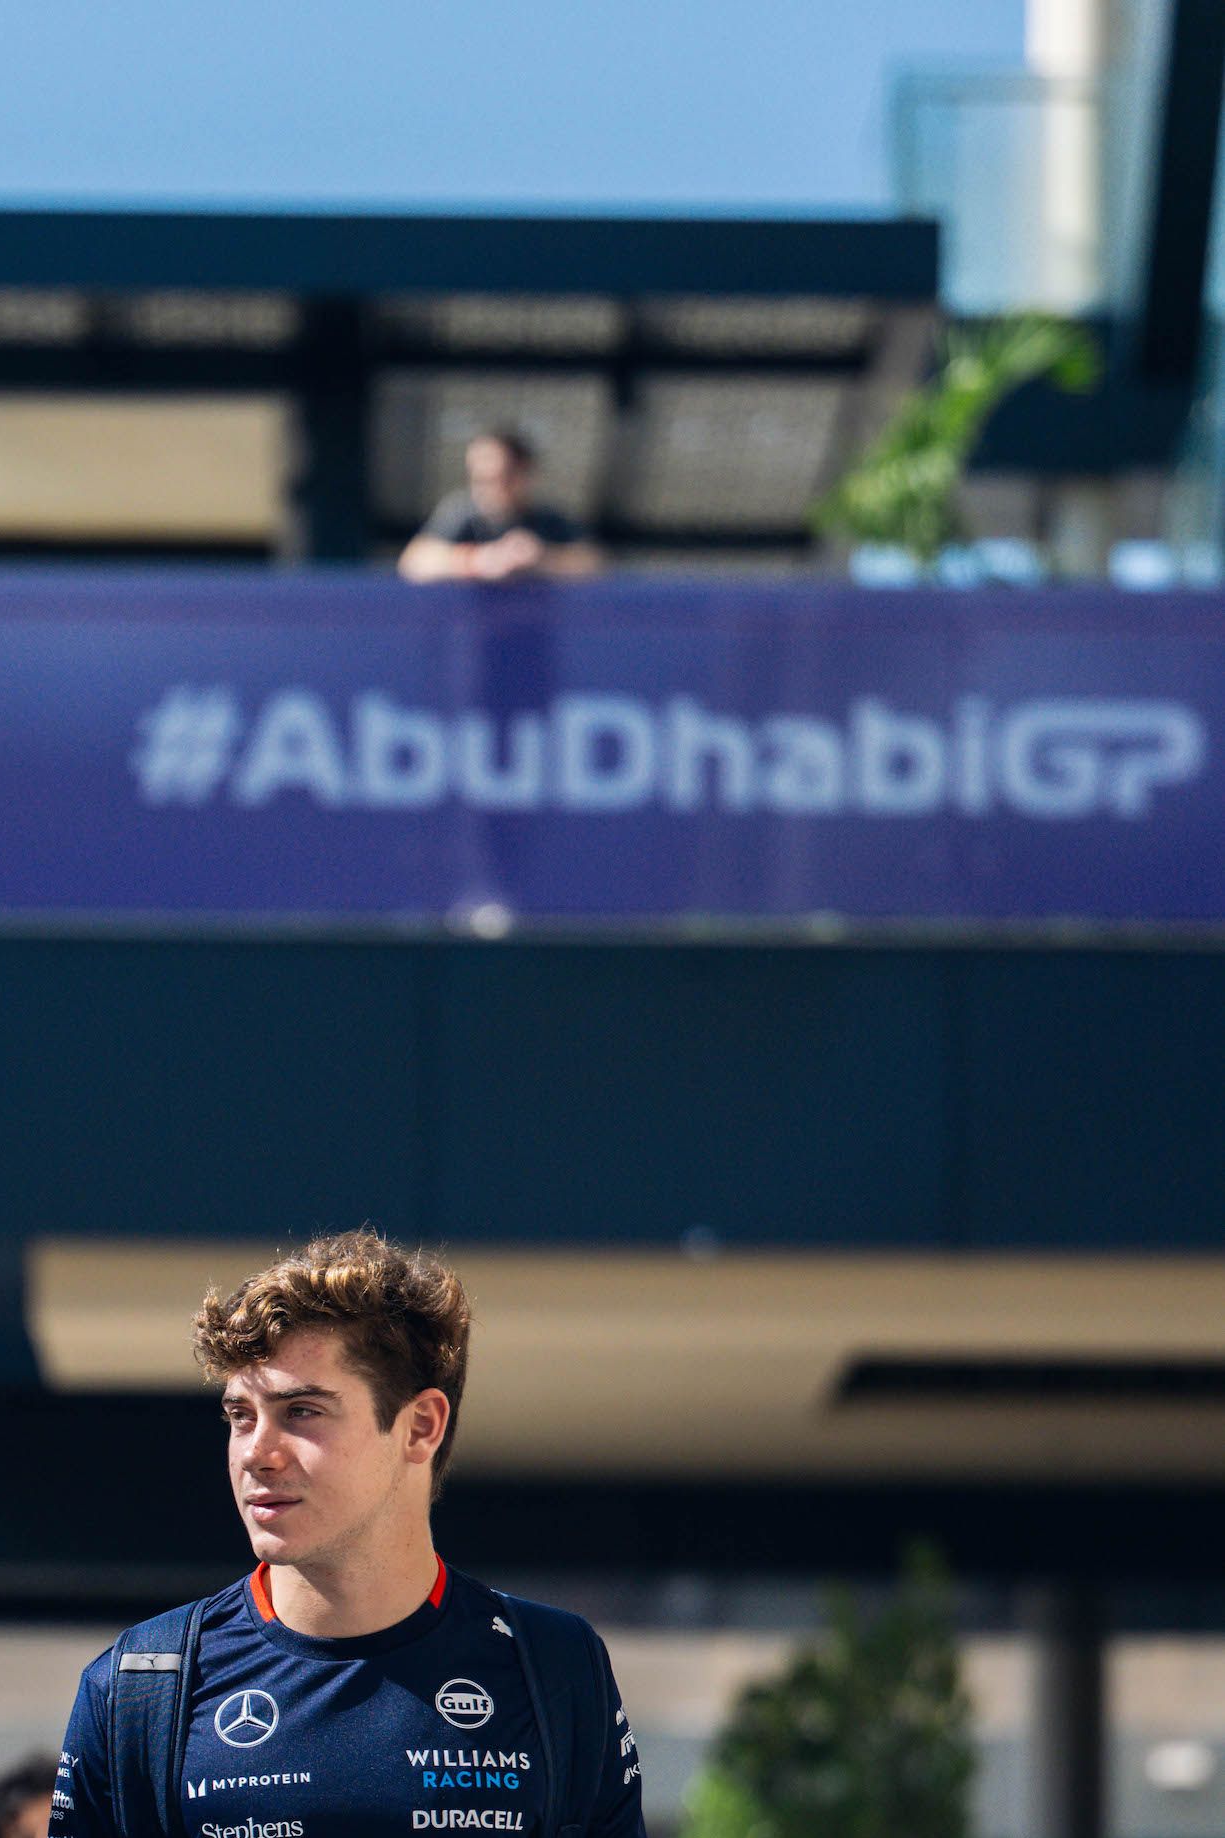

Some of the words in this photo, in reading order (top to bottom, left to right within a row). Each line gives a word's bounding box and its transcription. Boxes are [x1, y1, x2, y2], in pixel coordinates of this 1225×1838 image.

[136, 690, 1200, 816] #AbuDhabiGP
[439, 1696, 489, 1711] Gulf
[405, 1749, 531, 1770] WILLIAMS
[212, 1772, 311, 1791] MYPROTEIN
[422, 1771, 519, 1790] RACING
[412, 1809, 524, 1831] DURACELL
